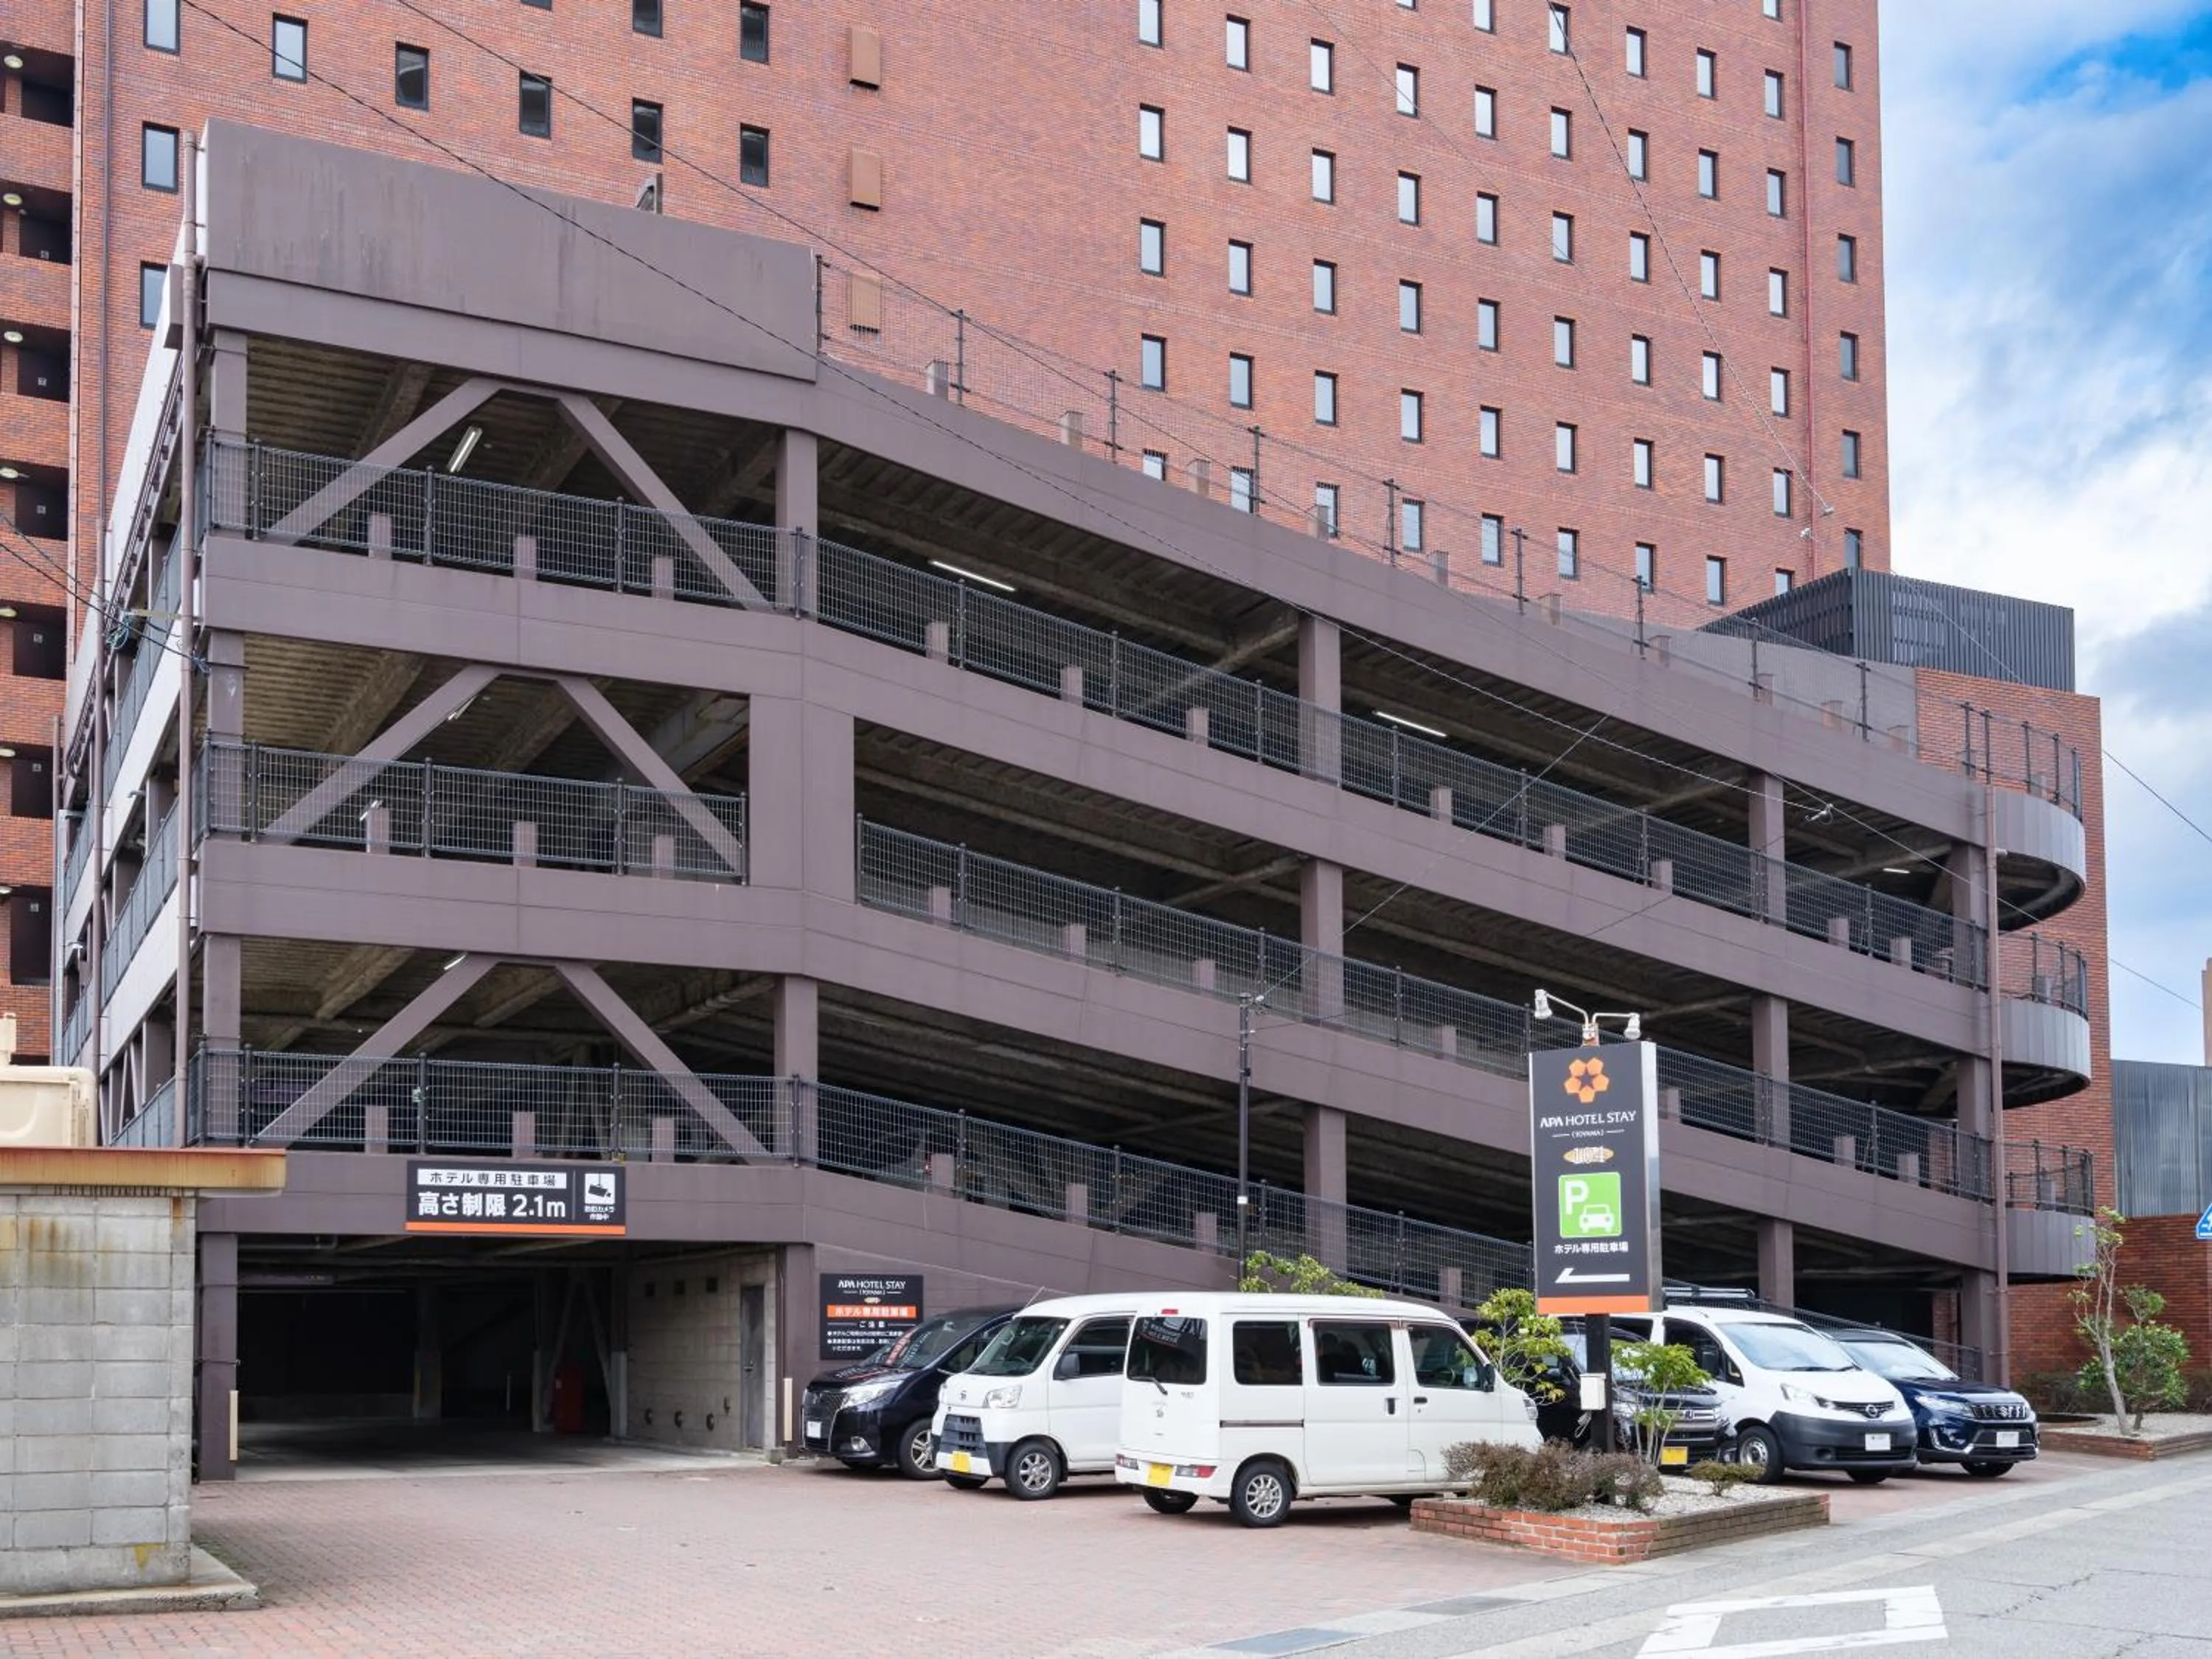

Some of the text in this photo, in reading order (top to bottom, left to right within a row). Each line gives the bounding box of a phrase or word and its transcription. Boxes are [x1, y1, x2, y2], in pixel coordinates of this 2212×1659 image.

[1540, 1110, 1636, 1128] APA HOTEL STAY
[430, 1172, 555, 1186] ホテル専用駐車場
[418, 1191, 566, 1217] 高さ制限 2.1m
[1564, 1180, 1590, 1215] P
[1554, 1241, 1629, 1254] ホテル専用駐車場
[838, 1279, 906, 1290] APA HOTEL STAY
